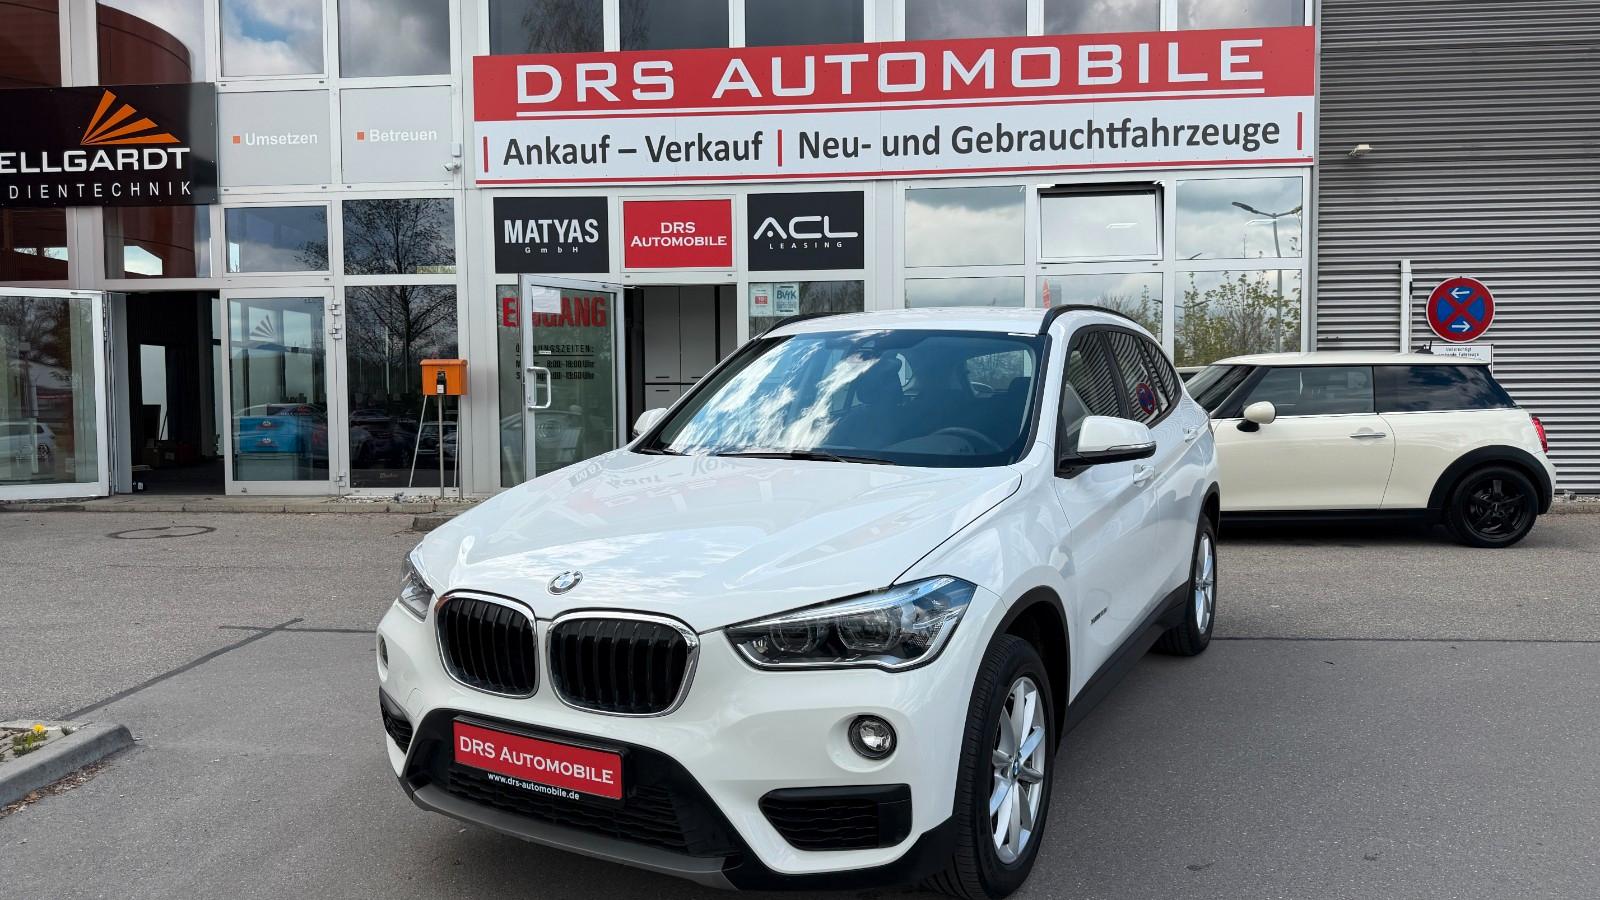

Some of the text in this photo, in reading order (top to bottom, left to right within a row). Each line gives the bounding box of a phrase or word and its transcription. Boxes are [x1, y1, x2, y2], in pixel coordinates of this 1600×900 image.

[517, 39, 1264, 104] DRS AUTOMOBILE
[245, 132, 318, 146] Umsetzen
[369, 128, 438, 143] Betreuen
[503, 134, 611, 165] Ankauf
[645, 130, 763, 163] Verkauf
[799, 131, 872, 160] Neu-
[882, 125, 941, 157] und
[951, 116, 1280, 153] Gebrauchtfahrzeuge
[0, 147, 191, 174] ELLGARDT
[9, 180, 191, 199] DIENTECHNIK
[504, 218, 599, 244] MATYAS
[660, 221, 696, 234] DRS
[753, 215, 859, 240] ACL
[524, 246, 579, 254] GmbH
[630, 235, 728, 248] AUTOMOBILE
[769, 241, 842, 250] LEASING
[502, 296, 607, 328] EANG
[459, 735, 614, 785] DRS AUTOMOBILE
[487, 772, 580, 800] www.drs-automobile.de
